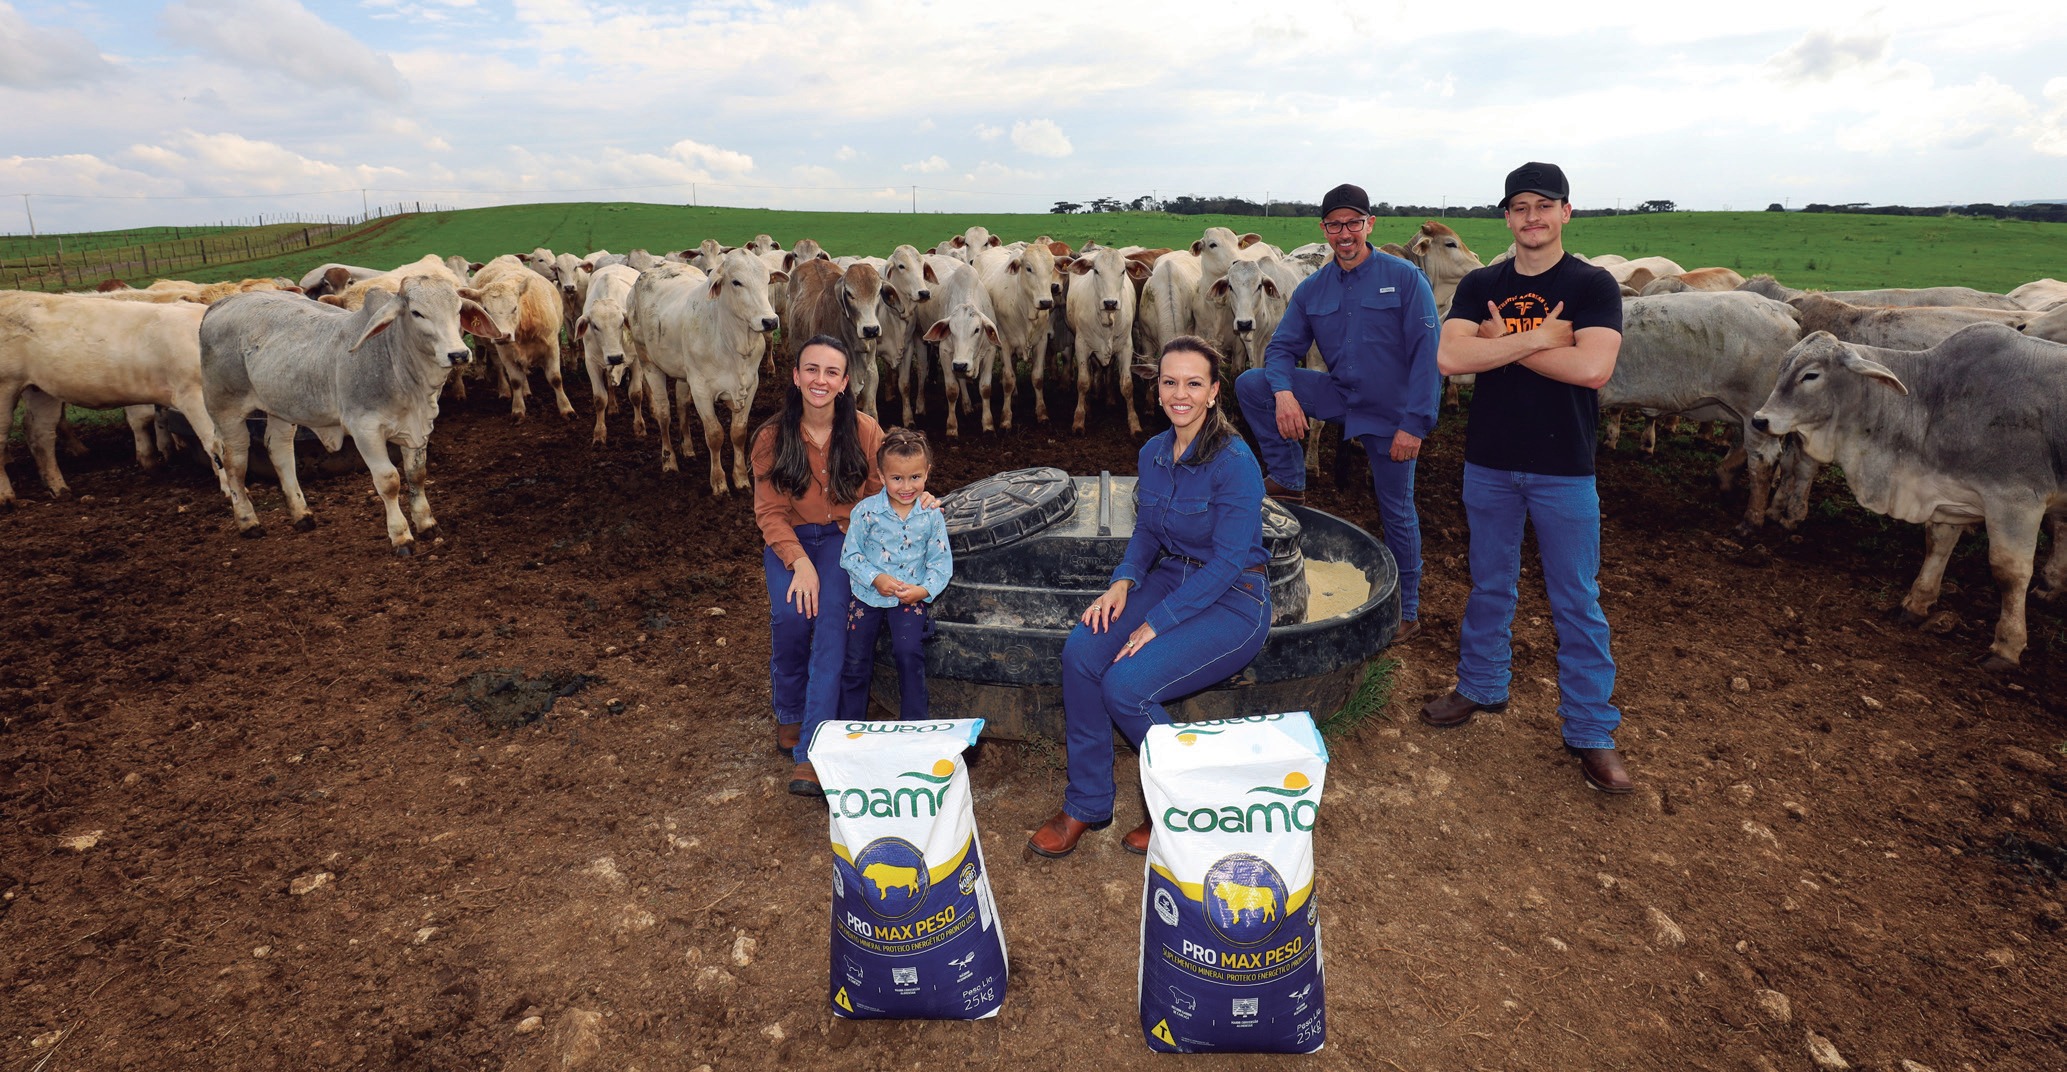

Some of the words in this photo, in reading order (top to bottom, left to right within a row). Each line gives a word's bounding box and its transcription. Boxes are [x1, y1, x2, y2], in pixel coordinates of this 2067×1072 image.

[845, 722, 955, 733] coamo
[1163, 799, 1319, 833] coamo
[847, 911, 872, 937] PRO
[874, 925, 914, 941] MAX
[915, 905, 955, 937] PESO
[859, 938, 882, 951] MINERAL
[945, 921, 965, 938] PRONTO
[1162, 947, 1197, 972] SUPLEMENTO
[1197, 967, 1225, 980] MINERAL
[1183, 939, 1217, 965] PRO
[1221, 952, 1262, 969] MAX
[1265, 936, 1302, 966] PESO
[840, 992, 846, 1006] T
[962, 985, 981, 998] Peso
[963, 987, 995, 1011] 25kg
[1160, 1025, 1168, 1038] T
[1296, 1017, 1313, 1032] Peso
[1296, 1020, 1322, 1045] 25kg
